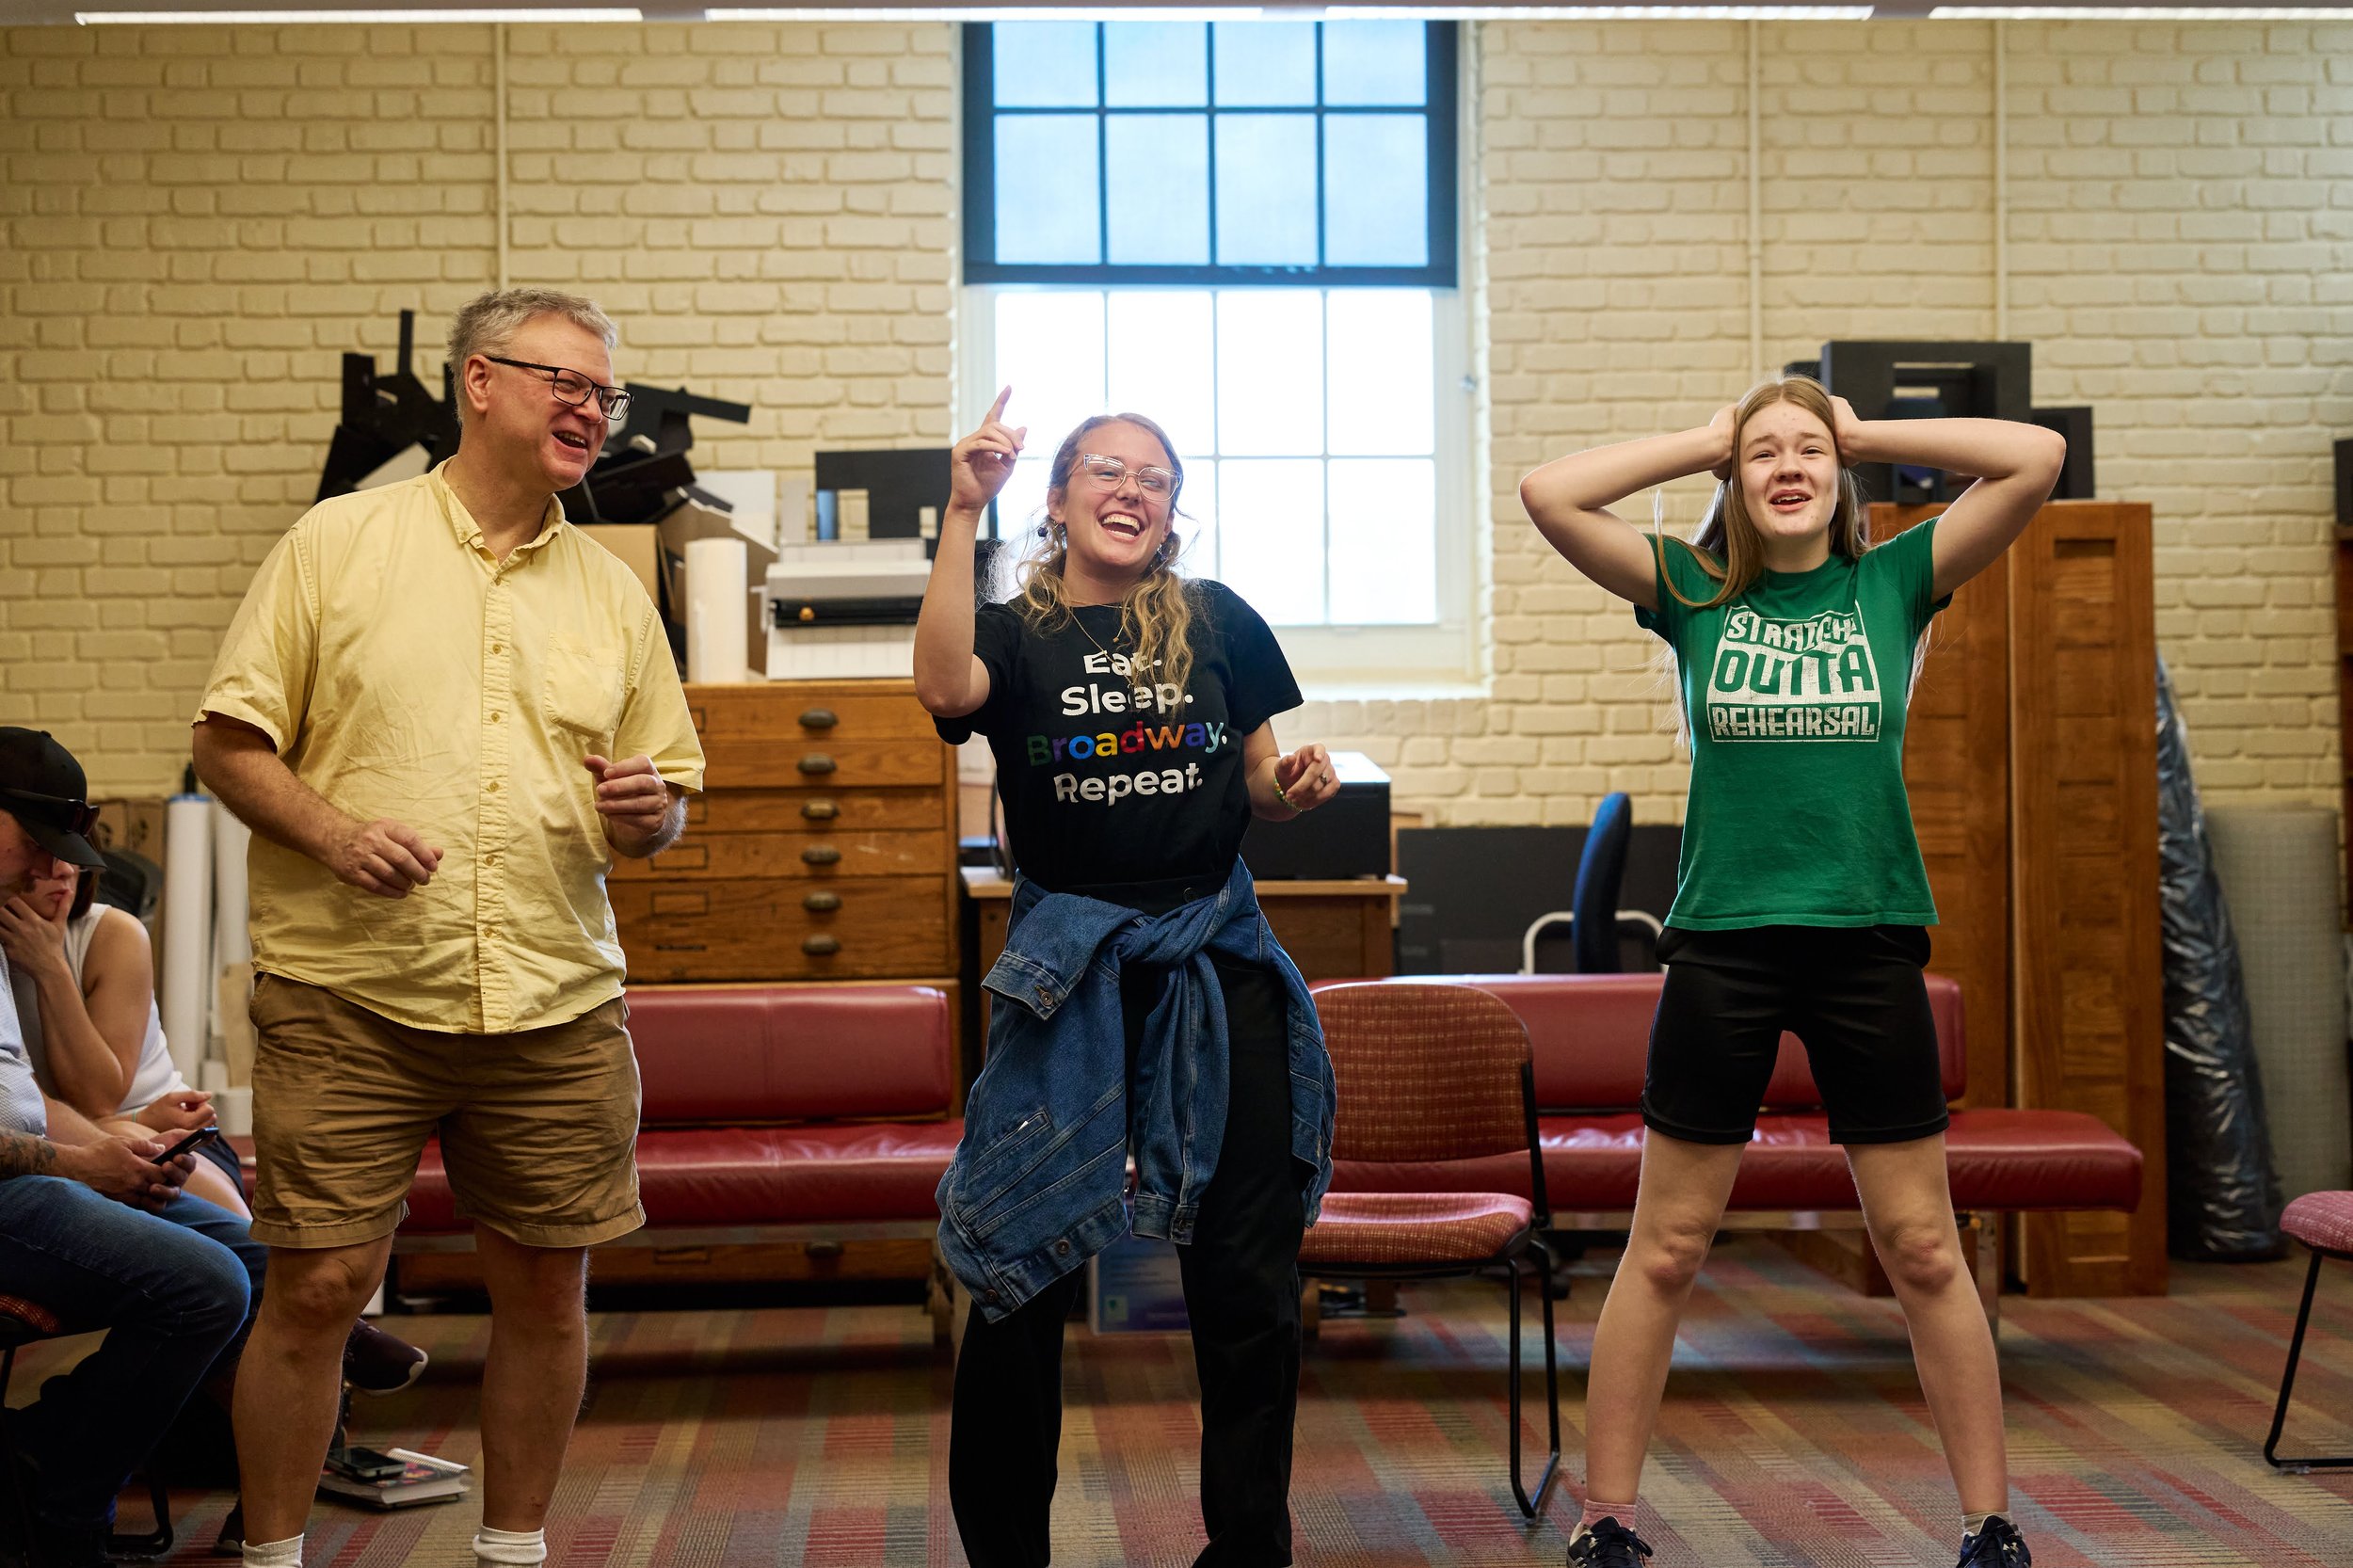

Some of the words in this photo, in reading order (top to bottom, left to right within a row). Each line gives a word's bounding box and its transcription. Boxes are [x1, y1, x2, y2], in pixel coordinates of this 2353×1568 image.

[1083, 650, 1162, 677] Eat.
[1715, 645, 1875, 696] OUTTA
[1061, 682, 1194, 715] Sleep.
[1712, 706, 1875, 737] REHEARSAL
[1027, 721, 1227, 767] Broadway.
[1053, 762, 1204, 807] Repeat.
